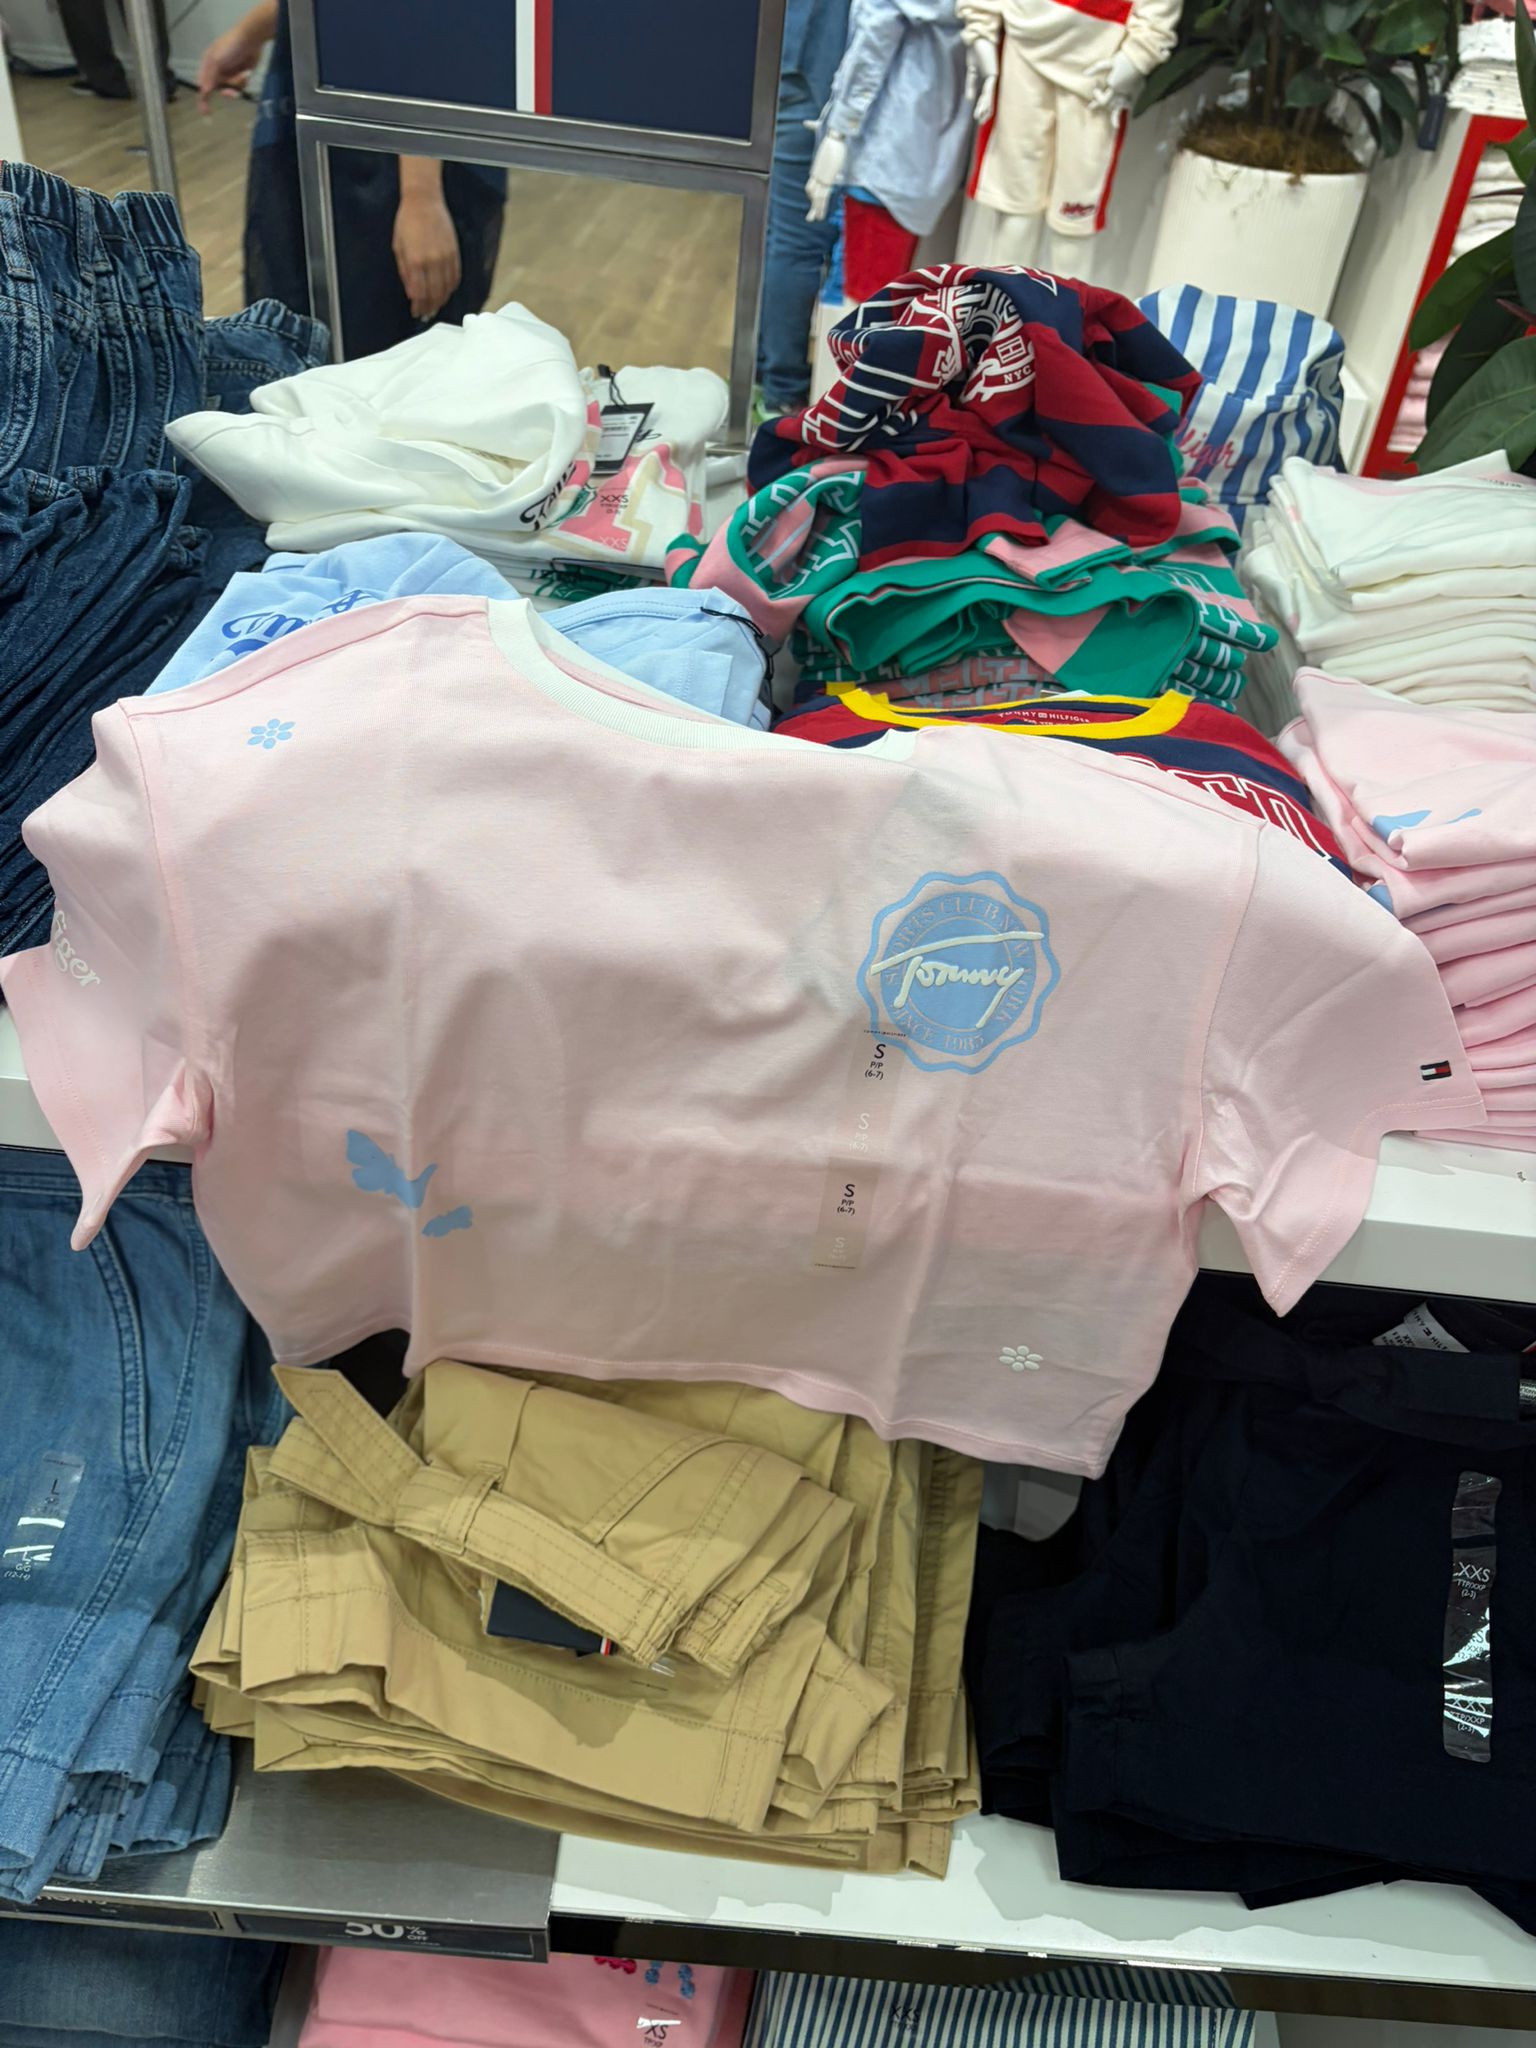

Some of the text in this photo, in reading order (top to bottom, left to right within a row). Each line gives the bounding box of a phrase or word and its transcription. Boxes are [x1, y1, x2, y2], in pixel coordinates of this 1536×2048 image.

[1003, 366, 1032, 385] NYC
[600, 495, 629, 503] XXS
[870, 931, 1045, 1029] Tommy
[874, 1043, 886, 1059] S
[870, 1061, 883, 1069] P/P
[865, 1069, 884, 1080] (6-7)
[858, 1112, 870, 1130] S
[844, 1183, 855, 1197] S
[837, 1206, 855, 1215] (6-7)
[51, 1479, 59, 1496] L
[1458, 1561, 1491, 1583] XXS
[645, 2024, 669, 2040] XS
